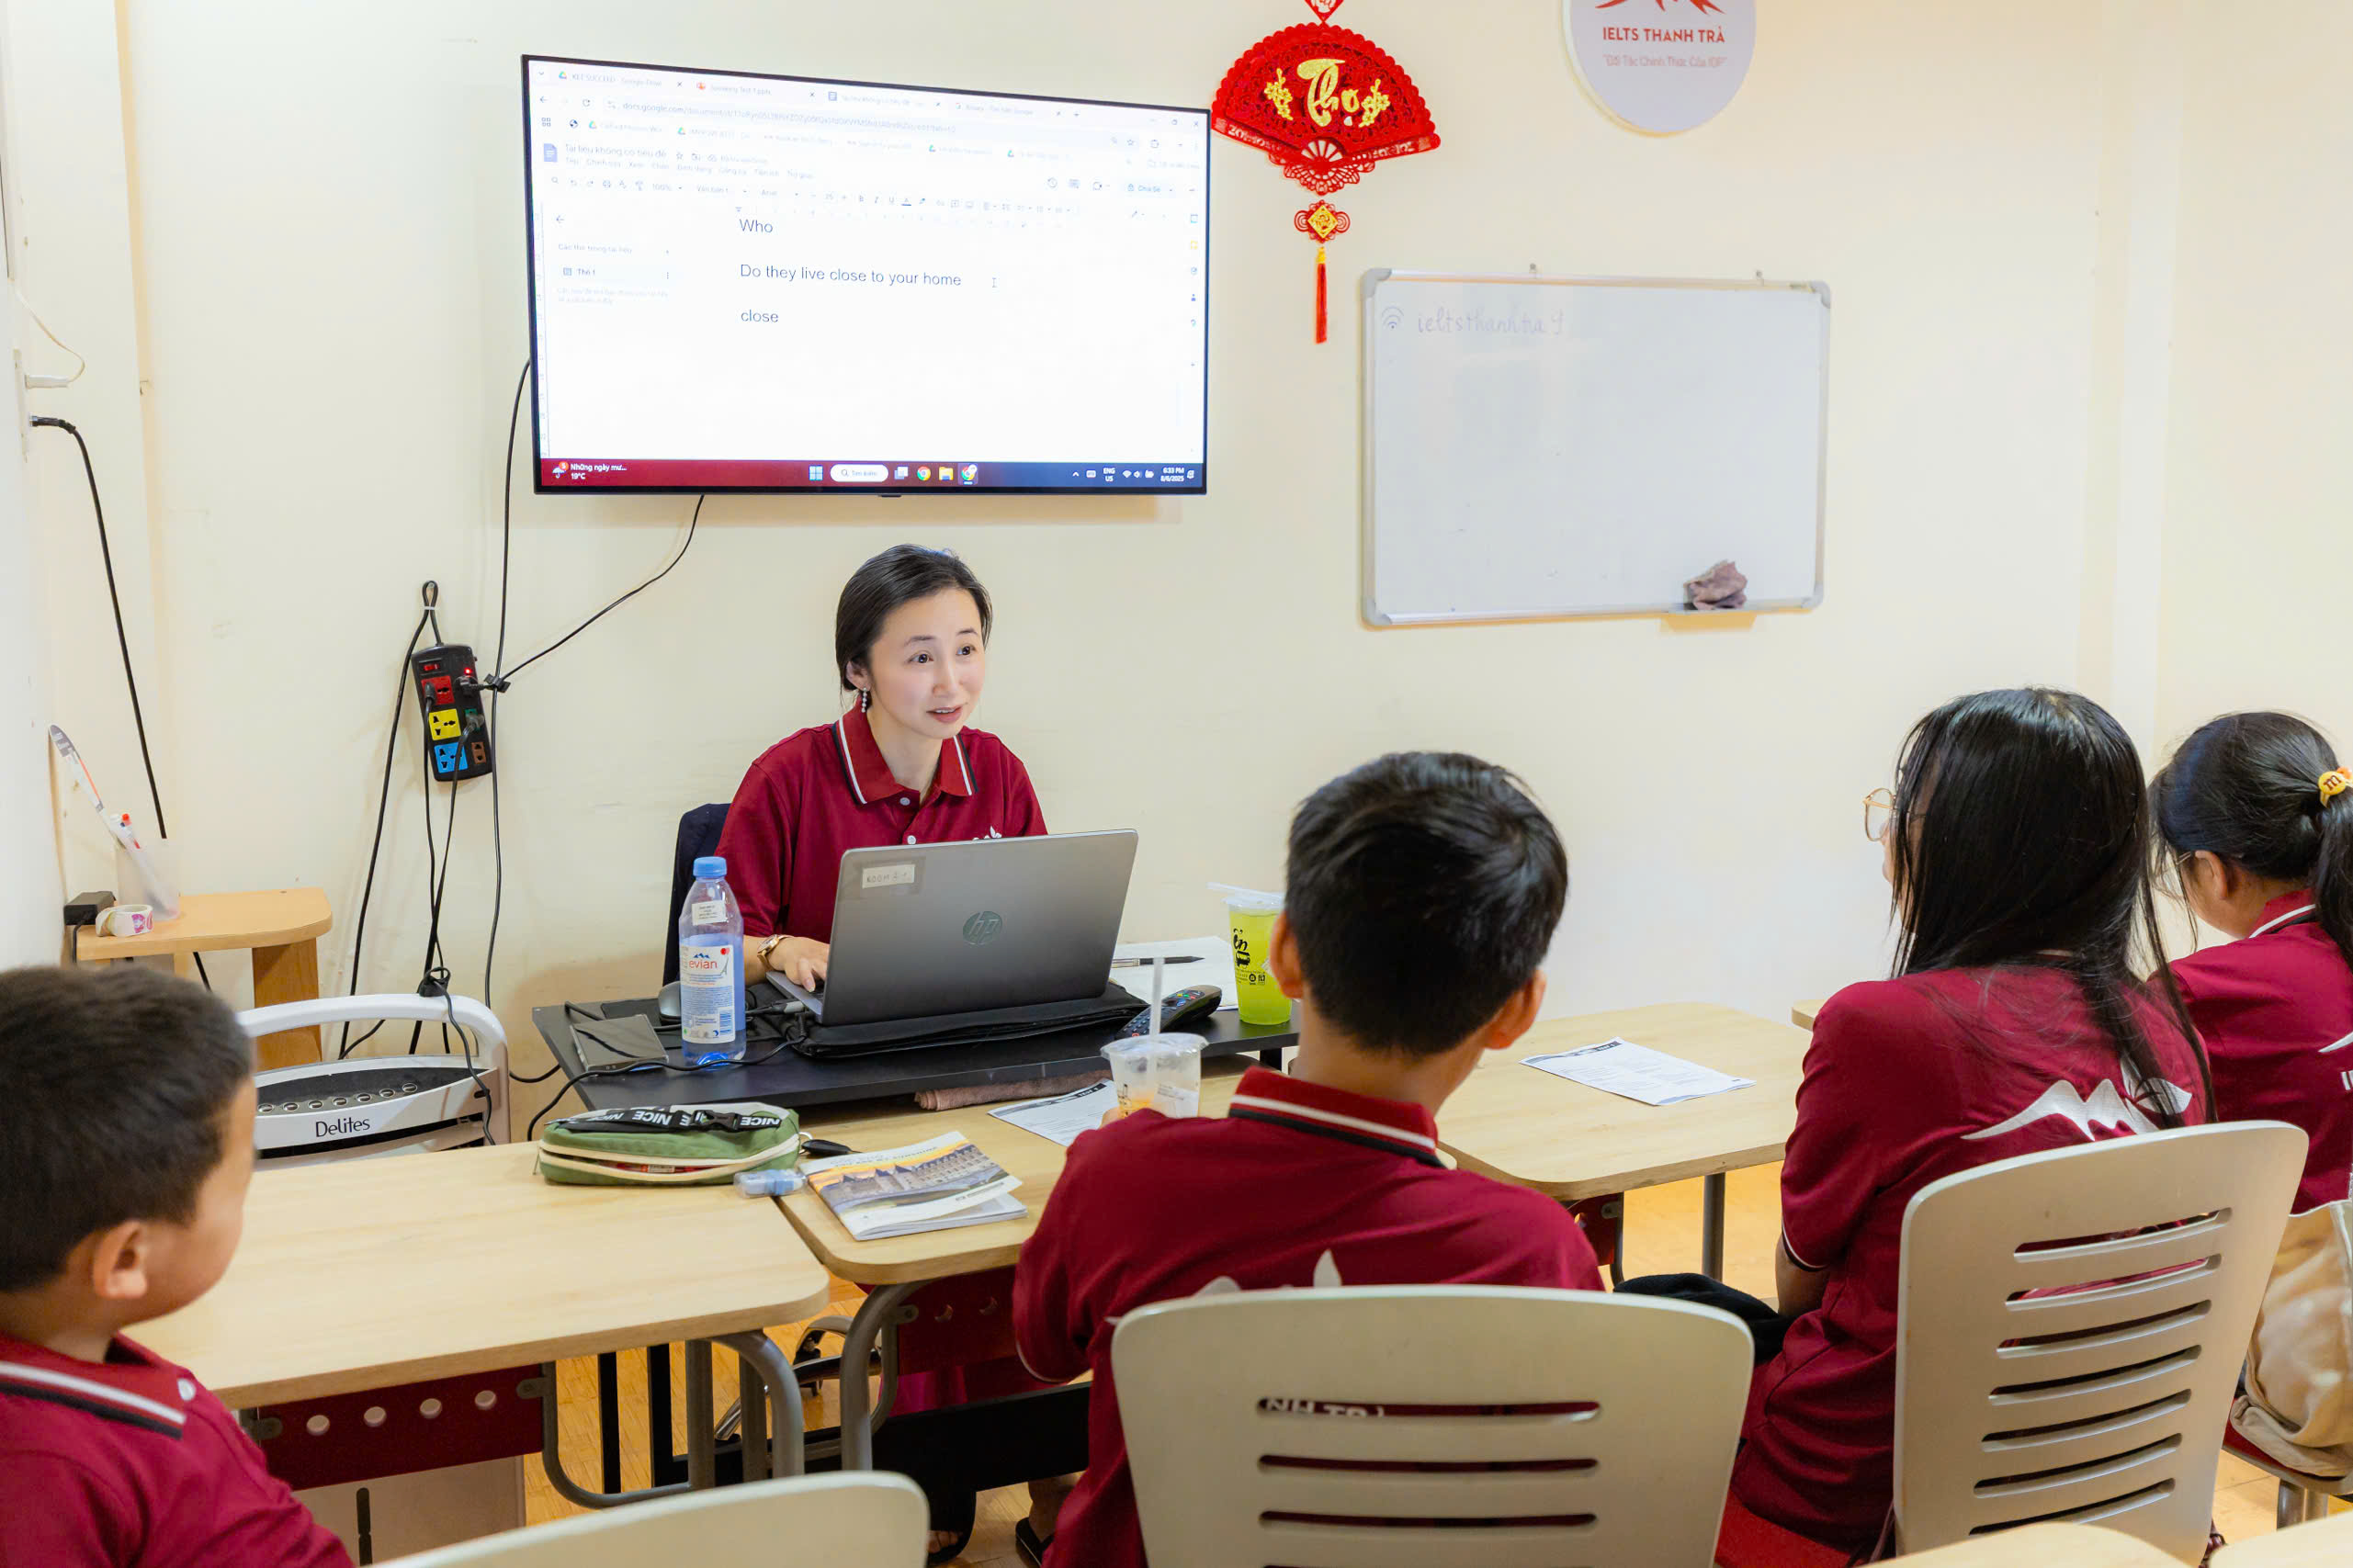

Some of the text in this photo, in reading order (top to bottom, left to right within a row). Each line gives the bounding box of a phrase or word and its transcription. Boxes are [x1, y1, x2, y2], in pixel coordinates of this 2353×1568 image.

[1602, 27, 1639, 40] IELTS
[1644, 28, 1693, 42] THANH
[740, 219, 774, 233] Who
[740, 264, 962, 287] Do they live close to your home
[741, 310, 779, 322] close
[969, 911, 1000, 946] hp
[689, 960, 718, 969] evian
[632, 1111, 672, 1125] NICE
[741, 1117, 780, 1126] NICE
[315, 1117, 370, 1137] Delites
